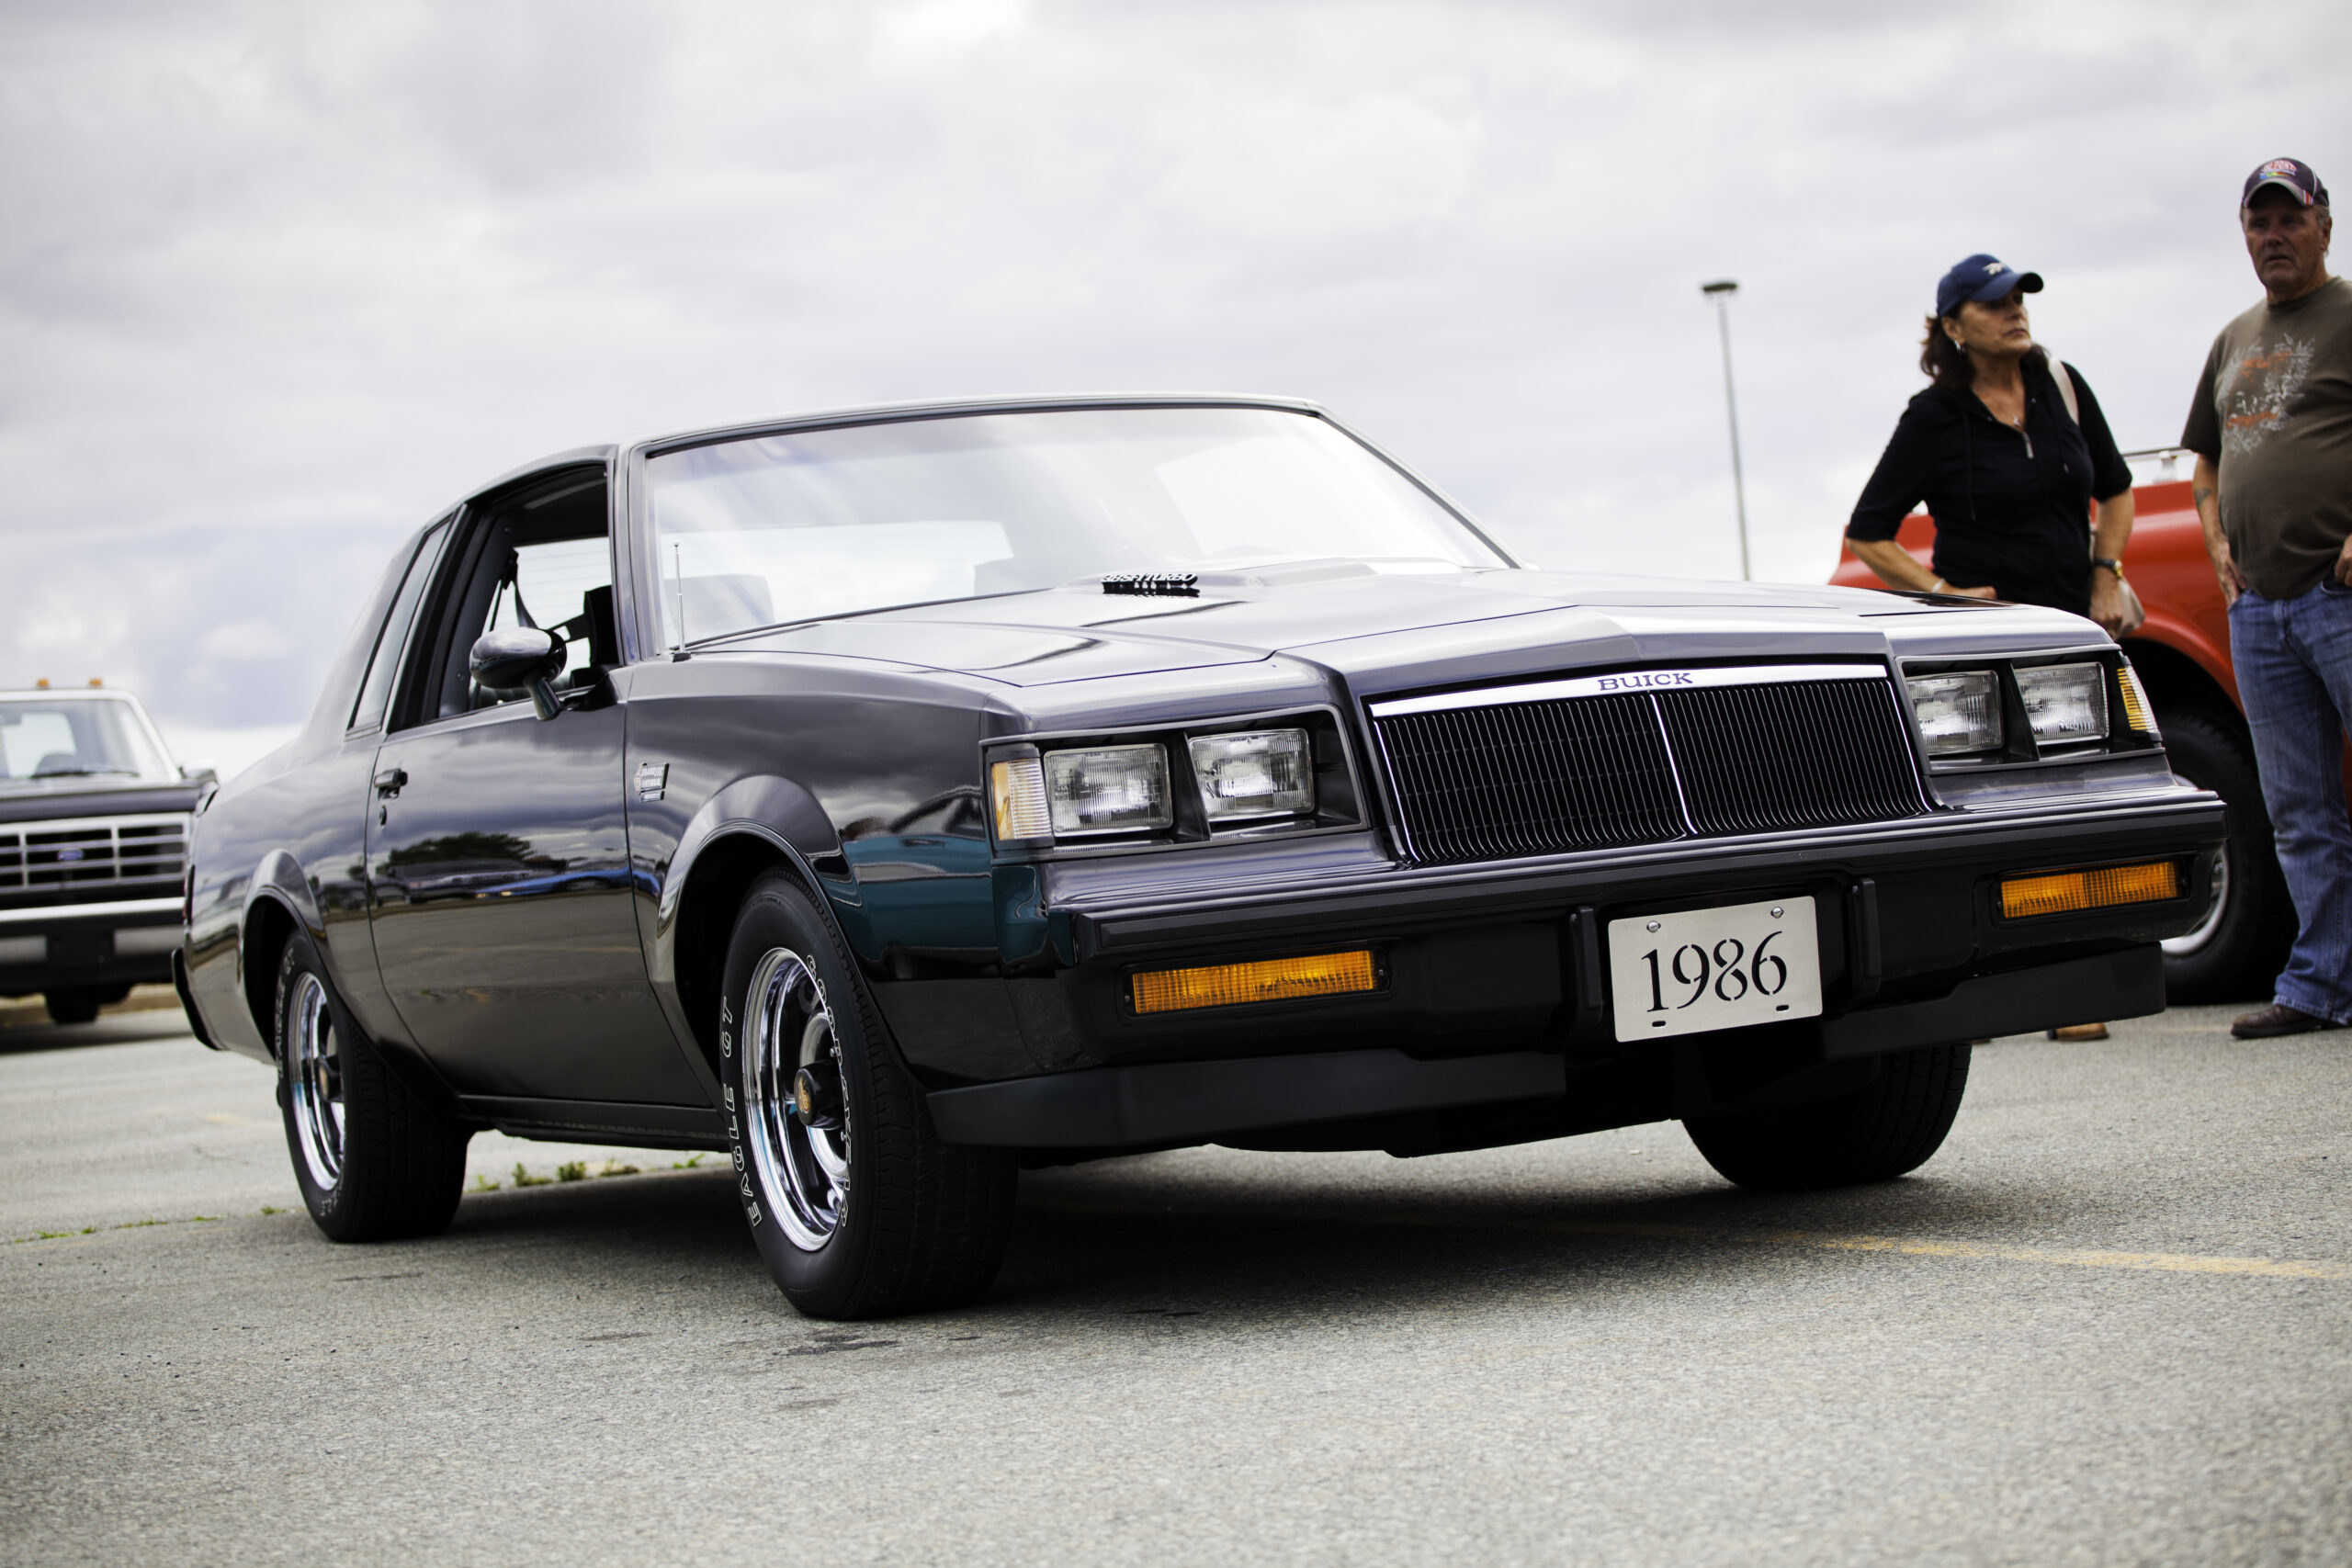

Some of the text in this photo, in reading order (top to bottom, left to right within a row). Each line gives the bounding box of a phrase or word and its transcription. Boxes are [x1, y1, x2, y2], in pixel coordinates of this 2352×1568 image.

[1598, 672, 1693, 691] BUICK
[1641, 931, 1788, 1013] 1986
[721, 996, 763, 1227] EAGLE GT
